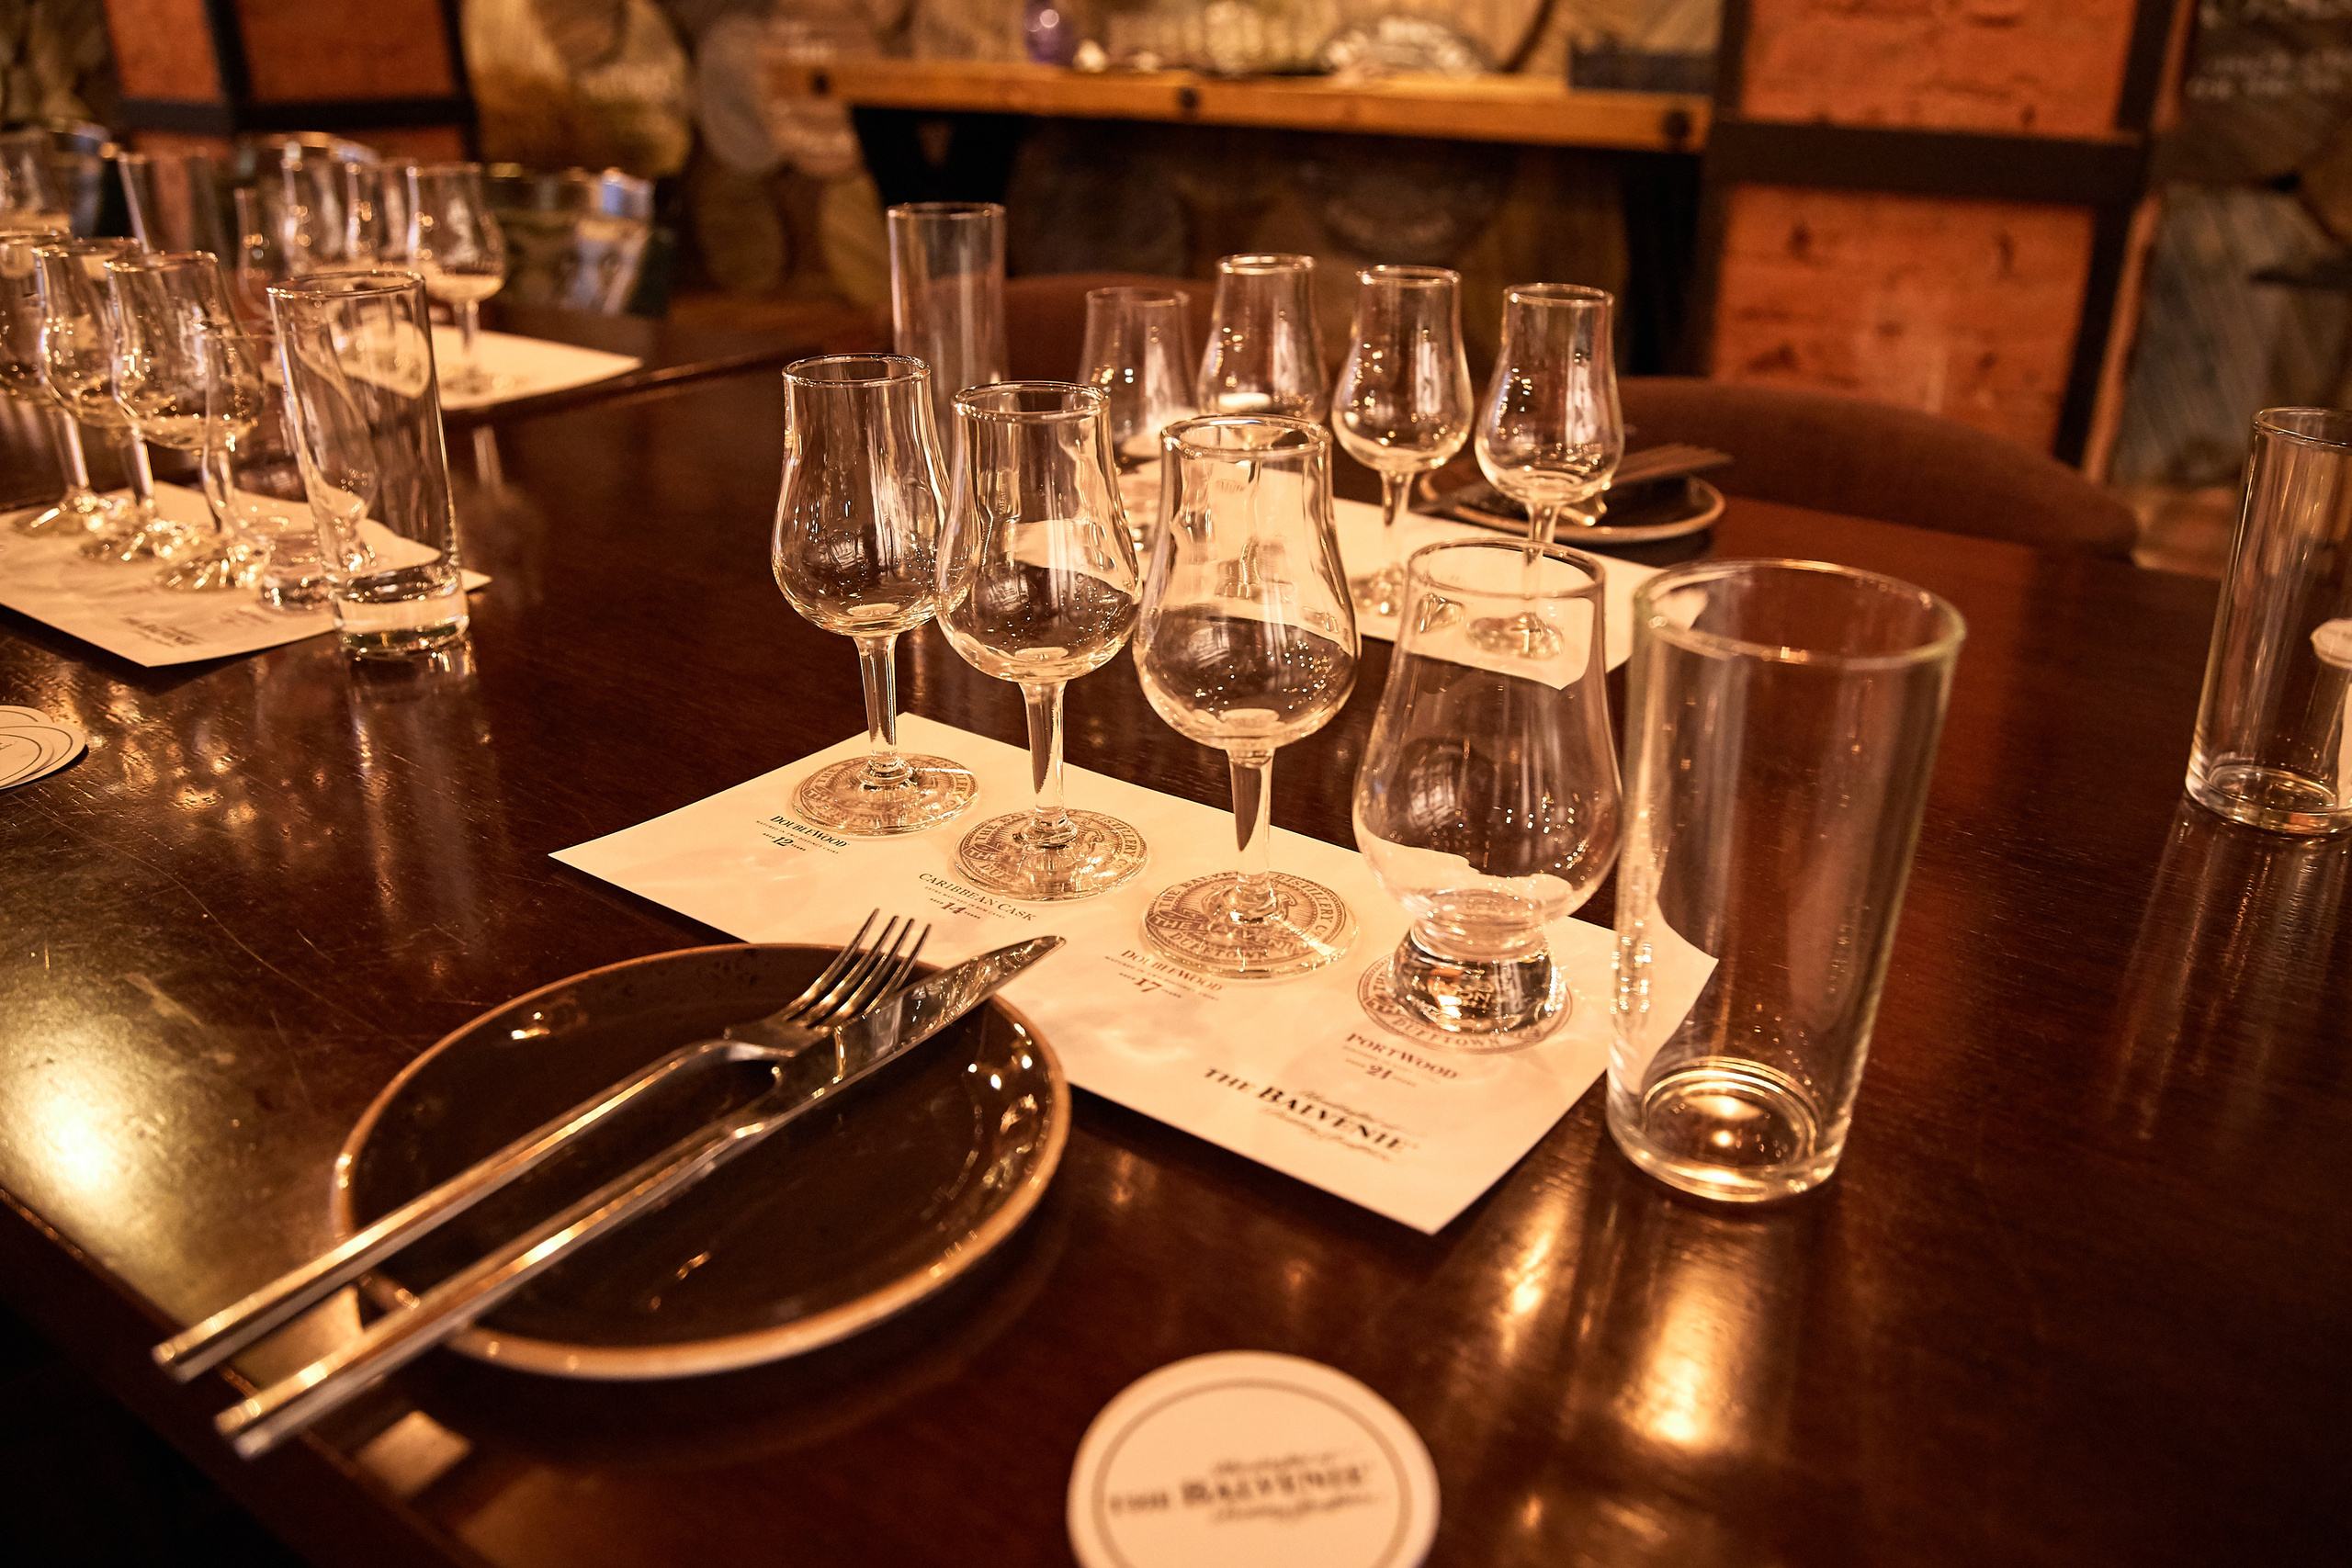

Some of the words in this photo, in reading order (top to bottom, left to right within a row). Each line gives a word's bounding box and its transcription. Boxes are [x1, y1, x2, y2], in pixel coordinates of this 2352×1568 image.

[773, 836, 794, 847] 12
[919, 873, 998, 906] CARIBBEAN
[998, 903, 1036, 920] CASK
[1273, 874, 1333, 923] DISTILLERY
[940, 902, 967, 914] 14
[1155, 917, 1193, 930] THE
[1134, 978, 1162, 993] 17
[1346, 1033, 1458, 1079] PORTWOOD
[1366, 1065, 1392, 1080] 21
[1204, 1068, 1256, 1093] THE
[1258, 1086, 1405, 1154] BALVENIE
